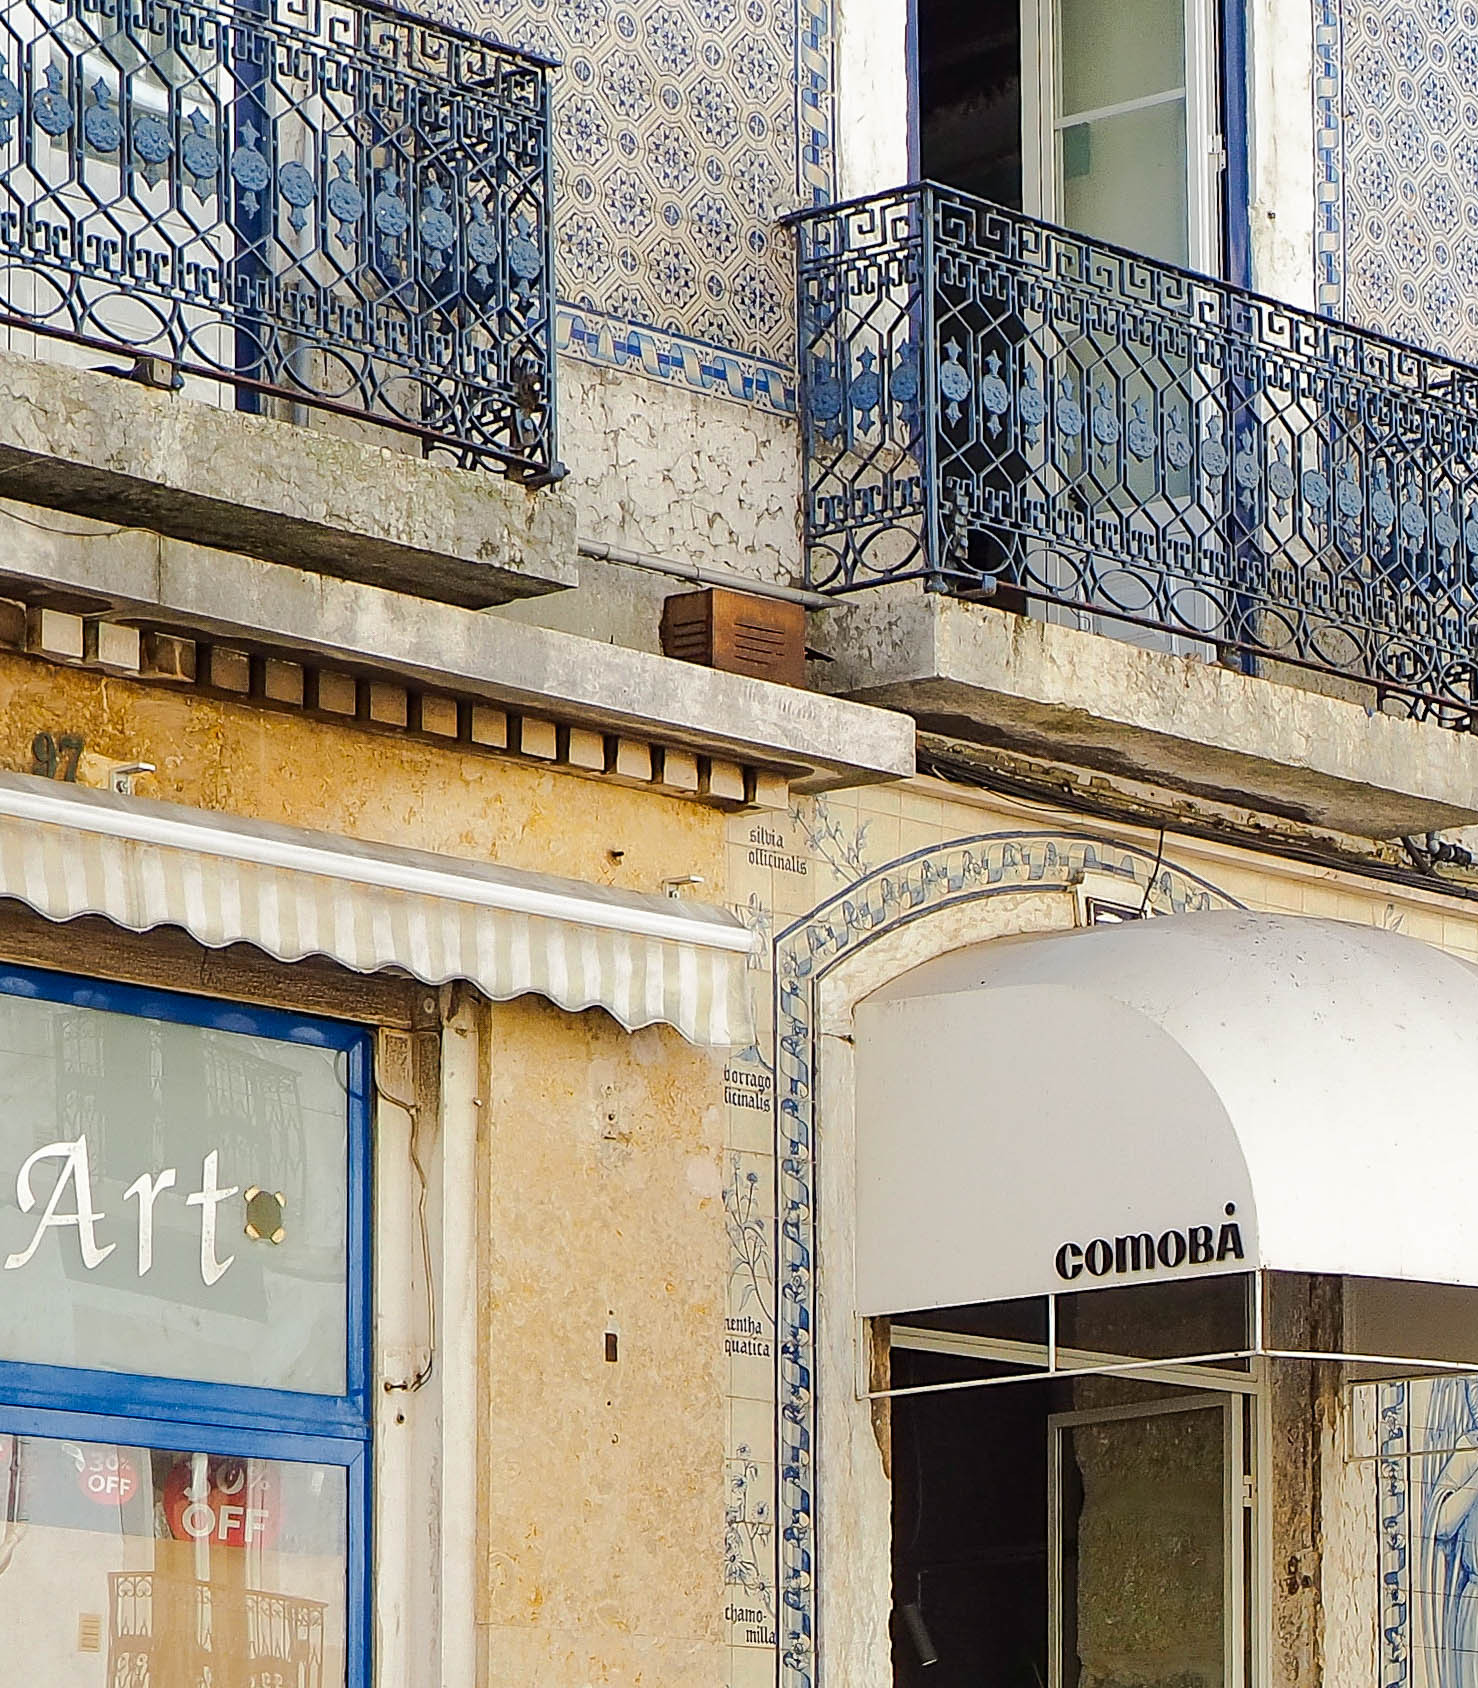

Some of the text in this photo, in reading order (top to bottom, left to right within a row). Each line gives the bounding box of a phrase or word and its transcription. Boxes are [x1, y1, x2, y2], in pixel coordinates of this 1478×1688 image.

[31, 731, 84, 783] 97
[3, 1133, 241, 1287] Art
[88, 1475, 131, 1496] OFF
[182, 1502, 269, 1543] OFF
[745, 1625, 776, 1645] milla
